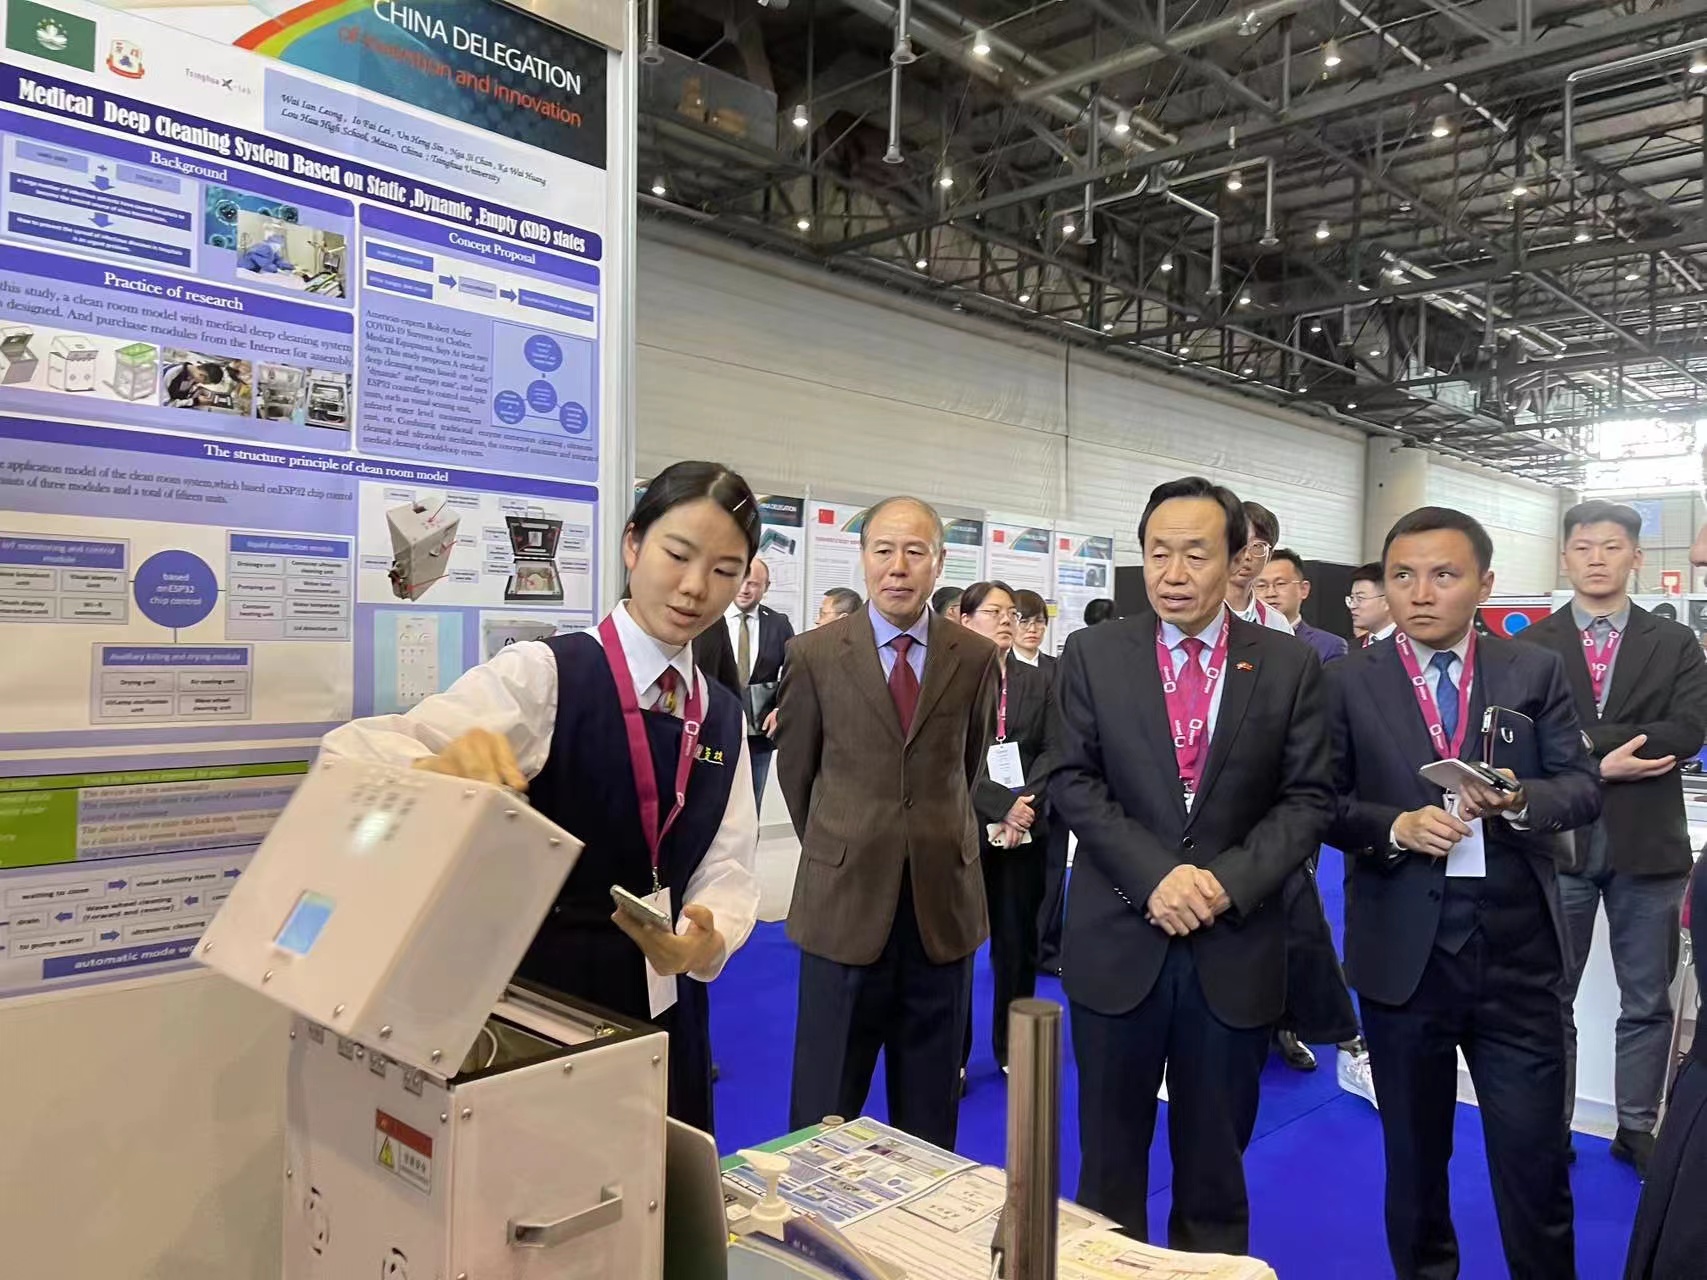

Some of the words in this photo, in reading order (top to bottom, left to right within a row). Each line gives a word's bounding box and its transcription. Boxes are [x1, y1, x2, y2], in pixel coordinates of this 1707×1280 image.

[373, 0, 448, 45] CHINA
[452, 26, 582, 96] DELEGATION
[455, 69, 490, 94] and
[493, 81, 583, 128] innovation
[18, 76, 94, 118] Medical
[103, 99, 151, 134] Deep
[155, 114, 231, 156] Cleaning
[234, 135, 289, 171] System
[292, 152, 341, 185] Based
[343, 170, 364, 192] on
[366, 173, 407, 204] Static
[519, 218, 551, 245] (SDE)
[552, 229, 586, 253] states
[150, 150, 228, 182] Background
[448, 232, 491, 254] Concept
[493, 243, 536, 265] Proposal
[103, 271, 163, 296] Practice
[166, 286, 182, 298] of
[185, 291, 244, 311] research
[66, 308, 93, 322] And
[96, 315, 149, 332] purchase
[150, 324, 198, 340] modules
[200, 331, 227, 346] from
[229, 335, 248, 349] the
[249, 339, 291, 355] Internet
[292, 345, 308, 359] for
[72, 294, 104, 308] clean
[106, 302, 139, 315] room
[141, 307, 178, 321] model
[179, 313, 203, 327] with
[205, 318, 248, 334] medical
[249, 325, 276, 341] deep
[277, 330, 319, 347] cleaning
[203, 443, 230, 459] The
[233, 449, 287, 464] structure
[289, 456, 339, 471] principle
[341, 460, 355, 472] of
[355, 462, 384, 475] clean
[385, 468, 415, 479] room
[416, 470, 449, 483] model
[74, 950, 140, 970] automatic
[141, 946, 176, 959] mode
